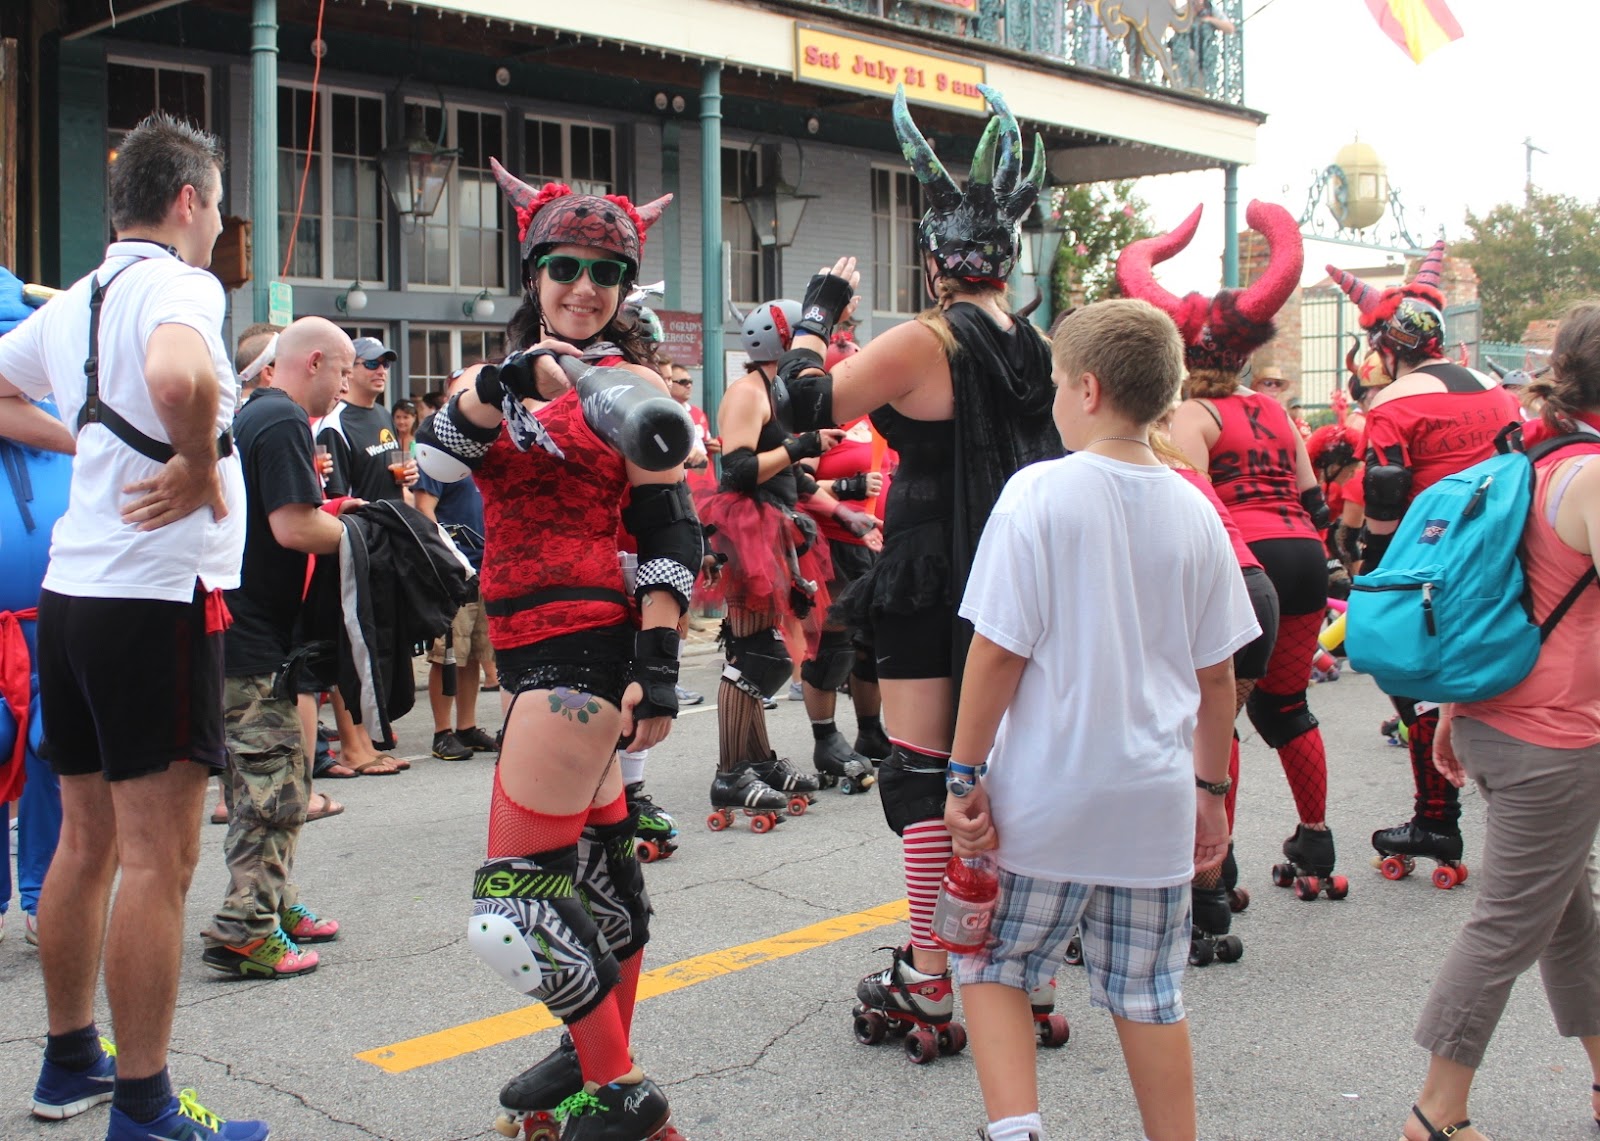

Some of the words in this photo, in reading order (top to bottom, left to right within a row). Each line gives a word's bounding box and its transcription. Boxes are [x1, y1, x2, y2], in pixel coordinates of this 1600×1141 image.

[805, 46, 840, 68] Sat
[852, 55, 898, 84] July
[904, 66, 926, 87] 21
[936, 73, 948, 91] 9
[952, 80, 980, 98] am
[961, 912, 990, 930] G2
